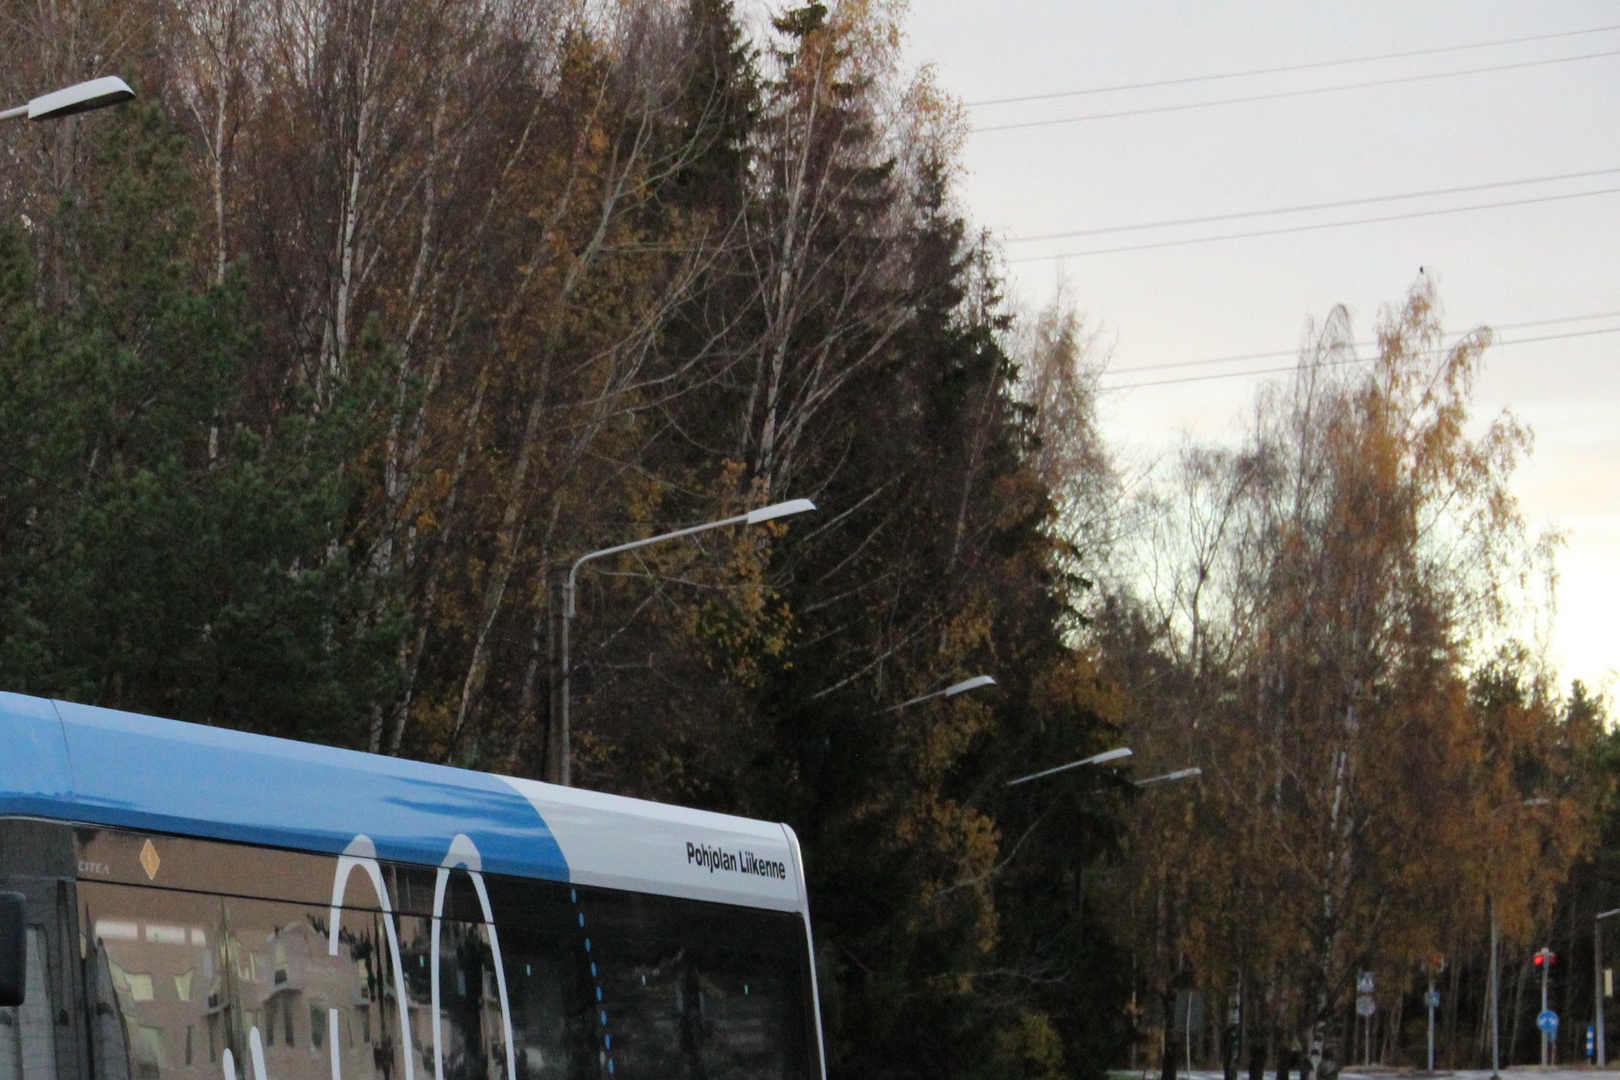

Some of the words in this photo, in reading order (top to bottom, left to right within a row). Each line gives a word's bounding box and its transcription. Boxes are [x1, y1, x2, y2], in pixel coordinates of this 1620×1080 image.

[78, 861, 110, 875] CITEA
[686, 842, 737, 874] Pohjolan
[739, 851, 786, 880] Liikenne
